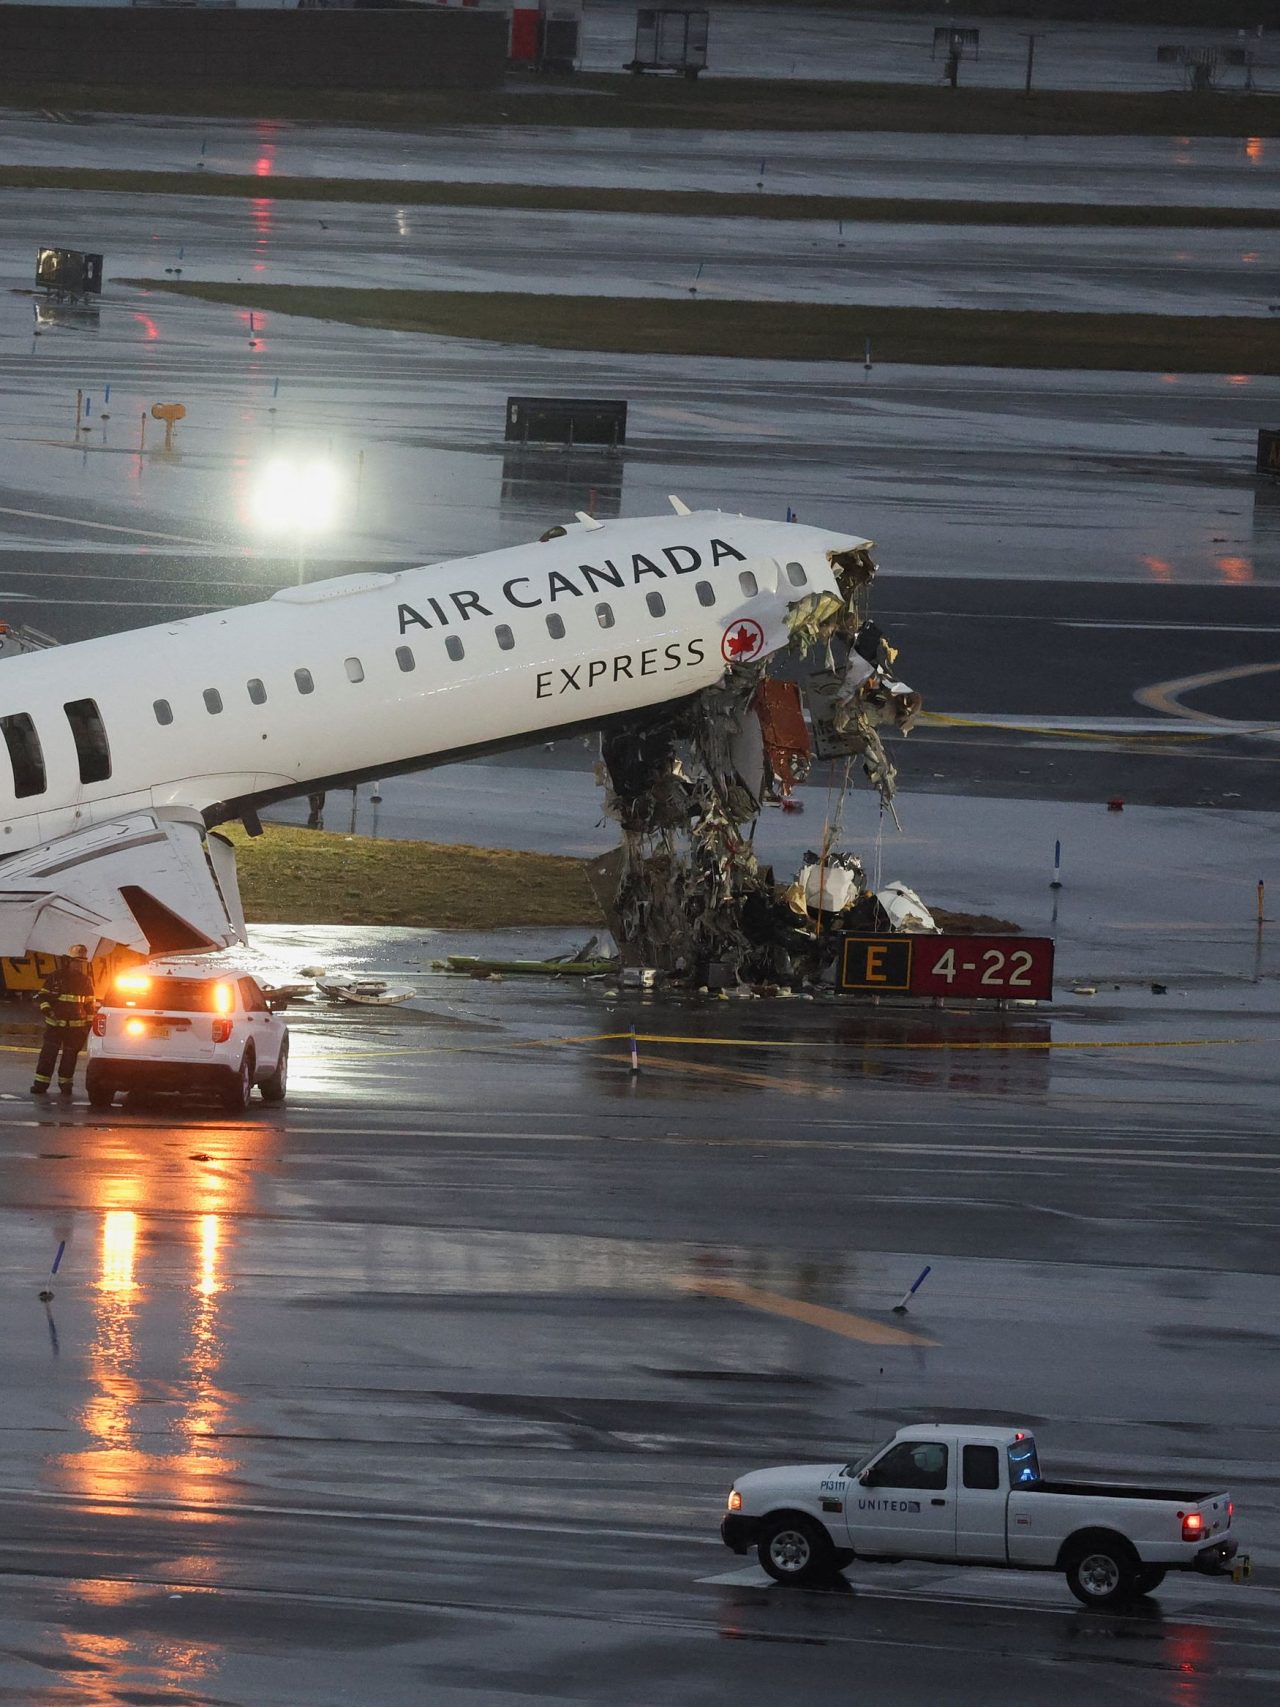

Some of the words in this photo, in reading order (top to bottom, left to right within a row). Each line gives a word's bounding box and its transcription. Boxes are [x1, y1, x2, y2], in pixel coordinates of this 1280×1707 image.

[397, 590, 493, 635] AIR
[502, 538, 747, 609] CANADA
[536, 638, 705, 699] EXPRESS
[865, 946, 887, 981] E
[931, 948, 1033, 986] 4-22
[858, 1500, 907, 1512] UNITED
